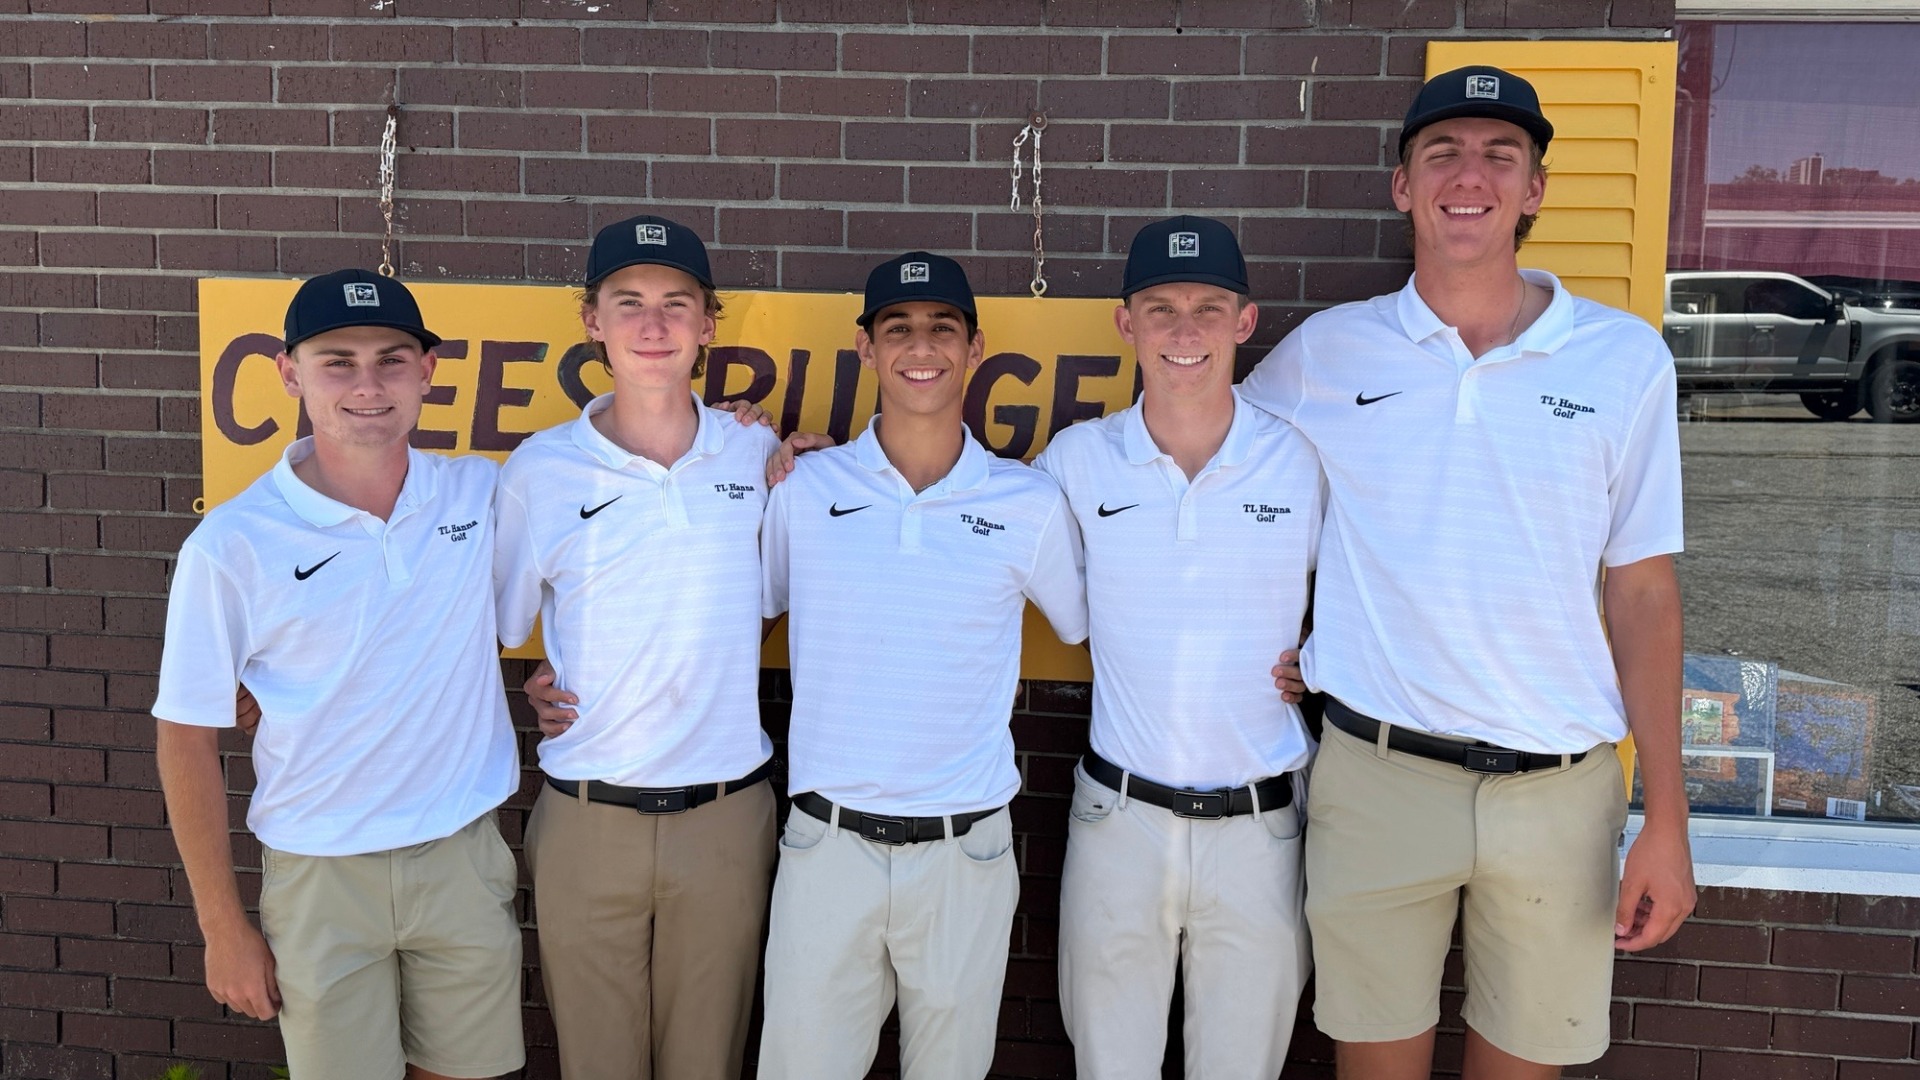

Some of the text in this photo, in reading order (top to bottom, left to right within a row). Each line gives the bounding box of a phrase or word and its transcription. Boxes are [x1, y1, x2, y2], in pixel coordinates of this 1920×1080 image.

[1540, 395, 1595, 413] TL Hanna
[1553, 407, 1576, 419] Golf
[714, 483, 755, 492] TL Hanna
[1243, 504, 1291, 514] TL Hanna
[961, 514, 1005, 531] TL Hanna
[1256, 514, 1276, 522] Golf
[437, 520, 478, 535] TL Hanna
[972, 525, 990, 536] Golf
[451, 532, 467, 542] Golf
